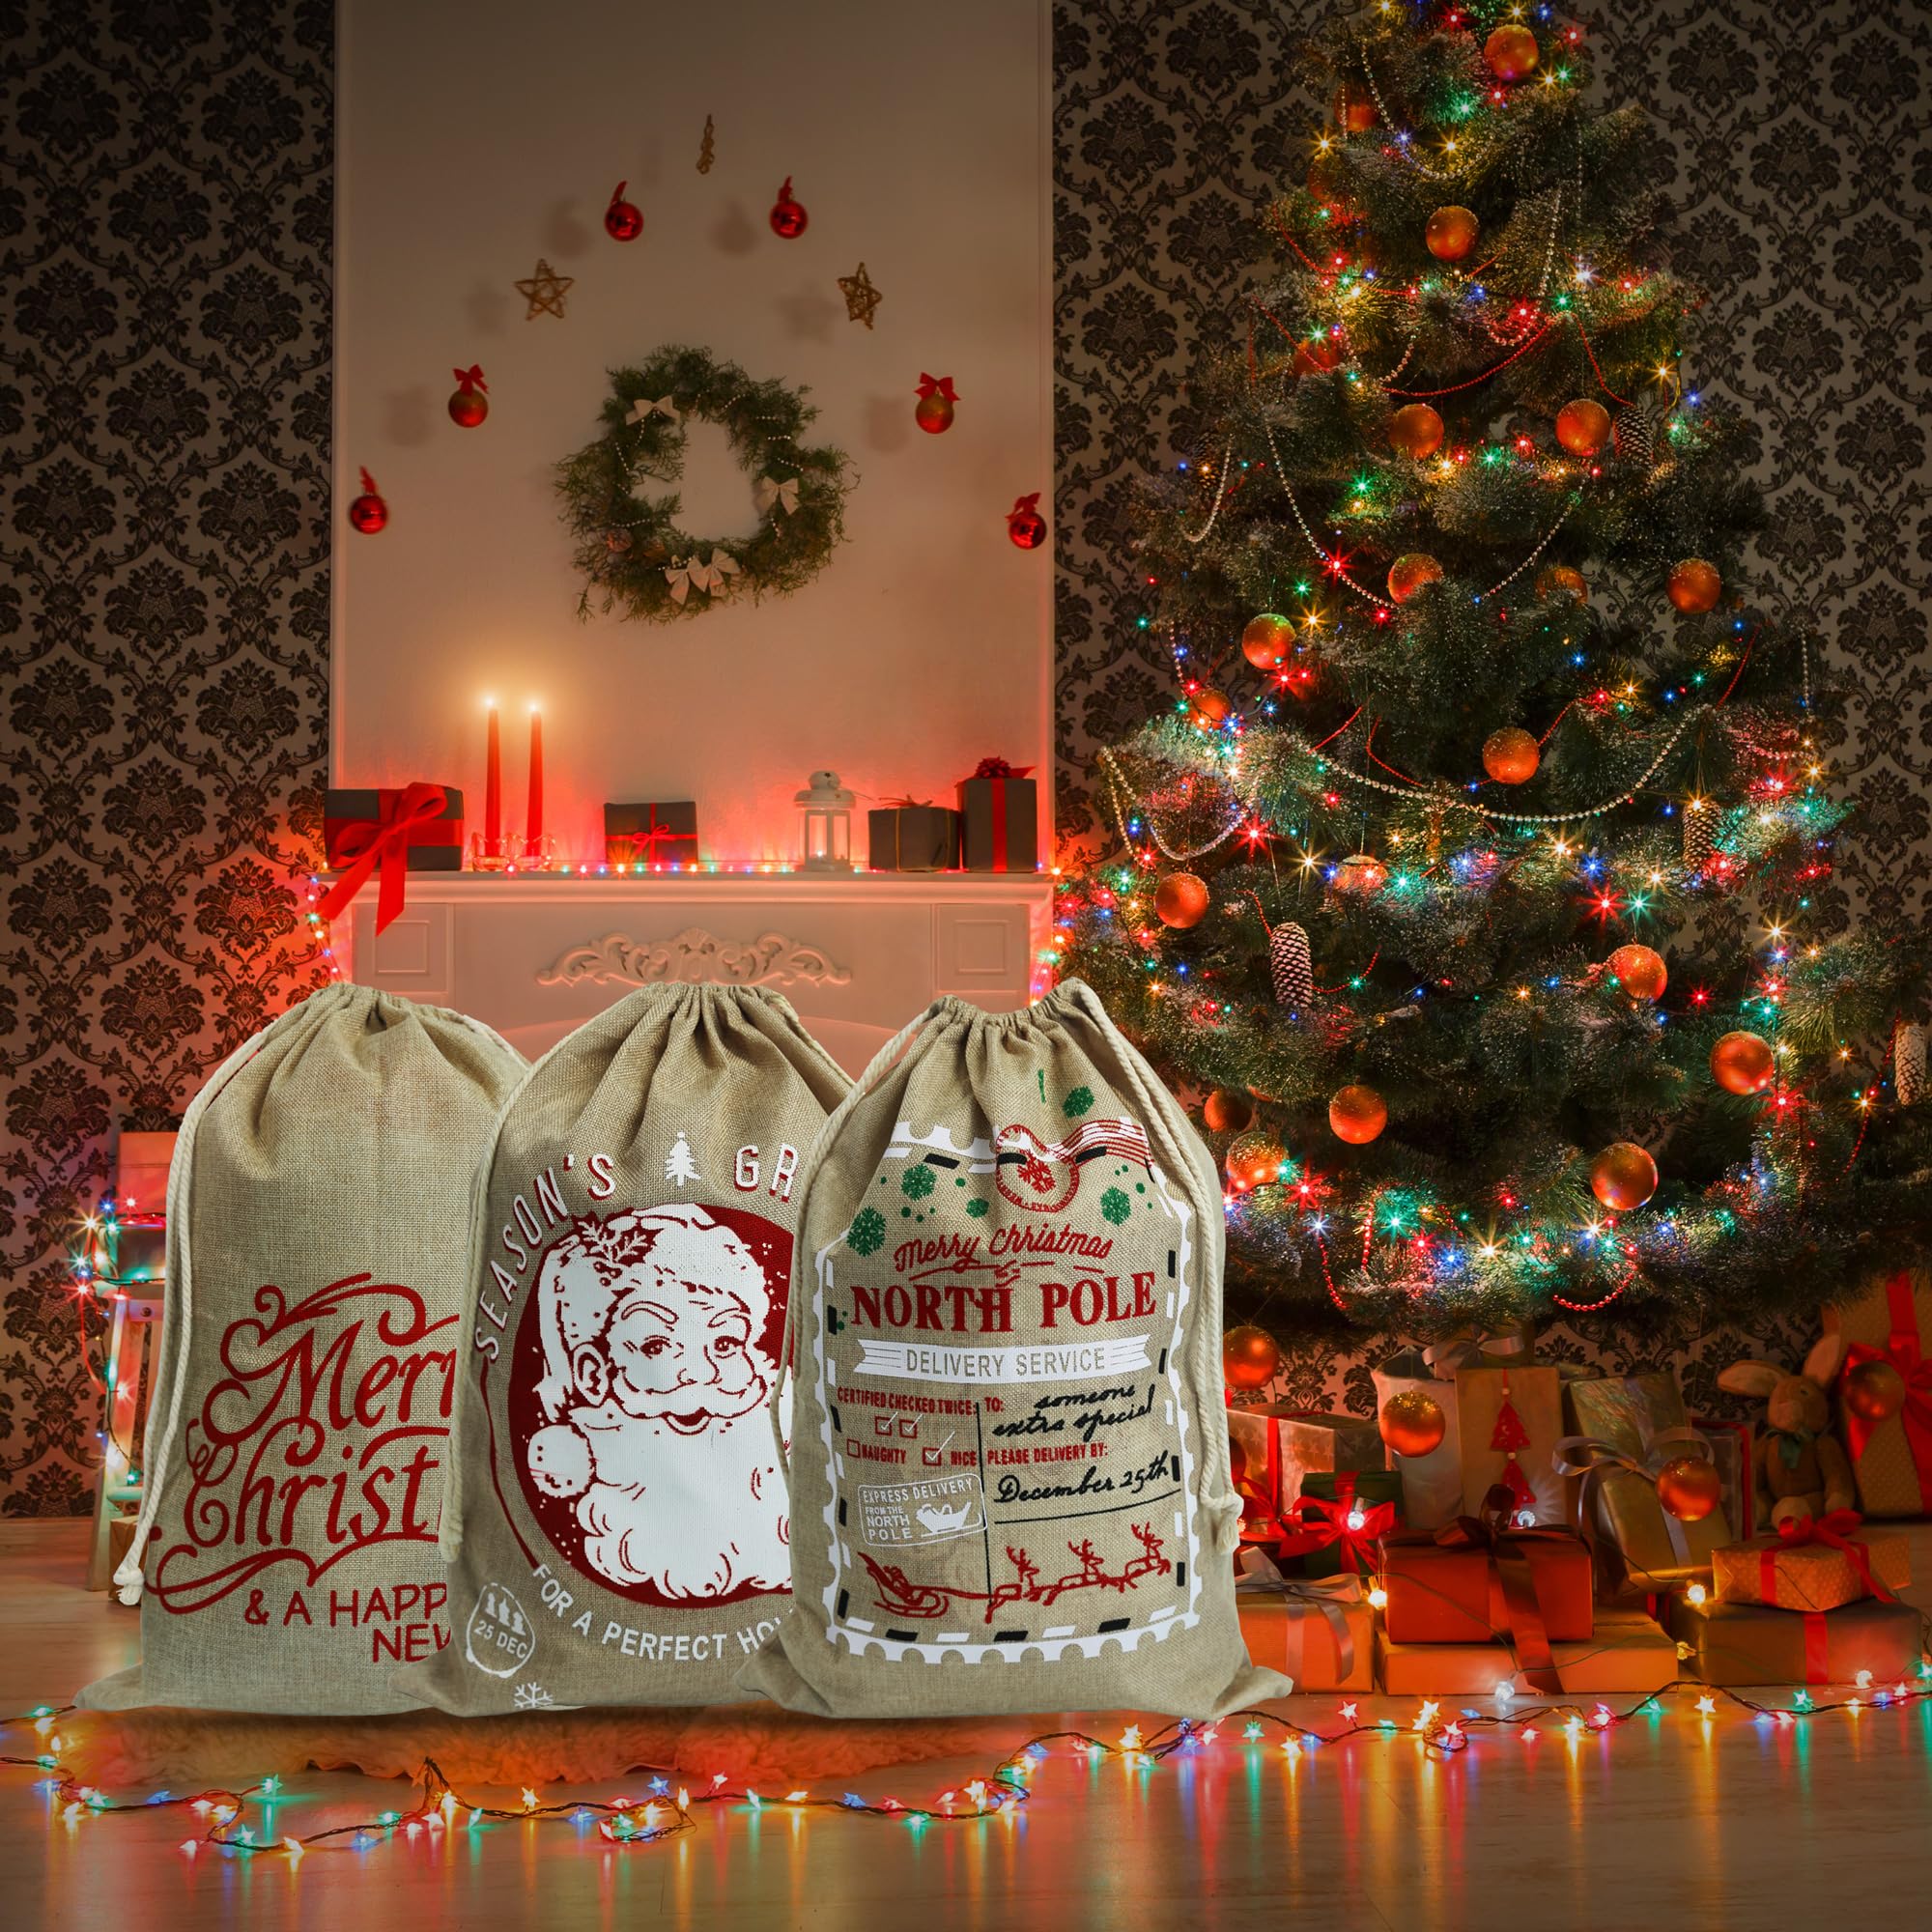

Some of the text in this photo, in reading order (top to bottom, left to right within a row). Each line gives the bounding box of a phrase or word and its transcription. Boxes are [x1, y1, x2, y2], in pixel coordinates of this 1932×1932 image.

[474, 1153, 616, 1361] SEASON'S
[894, 1223, 1114, 1273] Merry Christmas
[850, 1271, 1157, 1333] NORTH POLE
[906, 1348, 1105, 1378] DELIVERY SERVICE
[837, 1386, 886, 1408] CERTIFIED
[889, 1393, 935, 1413] CHECKED
[984, 1384, 1135, 1412] TO: someone
[992, 1383, 1155, 1442] extra special
[861, 1443, 978, 1467] NAUGHTY NICE
[987, 1442, 1109, 1465] PLEASE DELIVERY BY:
[184, 1417, 443, 1546] Christ
[863, 1478, 973, 1503] EXPRESS DELIVERY
[994, 1449, 1169, 1503] December 25th
[866, 1506, 887, 1515] FROM
[867, 1515, 910, 1527] NORTH
[867, 1527, 913, 1541] POLE
[244, 1589, 270, 1625] &
[283, 1590, 312, 1625] A
[533, 1563, 574, 1618] FOR
[572, 1610, 592, 1636] A
[601, 1621, 726, 1661] PERFECT
[473, 1620, 527, 1659] 25 DEC
